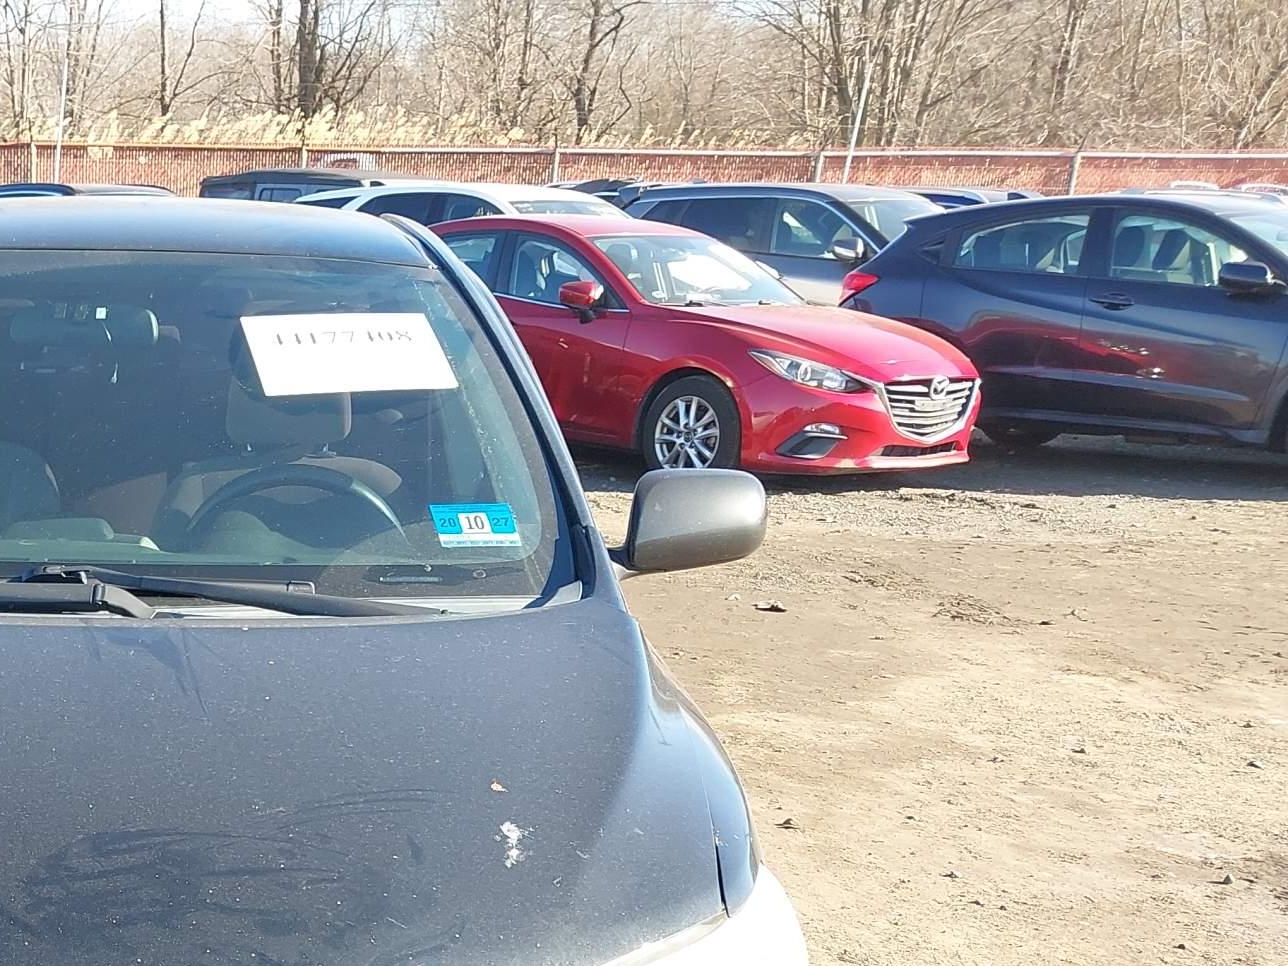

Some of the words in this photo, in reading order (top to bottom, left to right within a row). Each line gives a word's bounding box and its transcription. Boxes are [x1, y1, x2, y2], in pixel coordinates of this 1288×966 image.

[439, 518, 457, 528] 20
[464, 515, 485, 531] 10
[492, 517, 509, 527] 27
